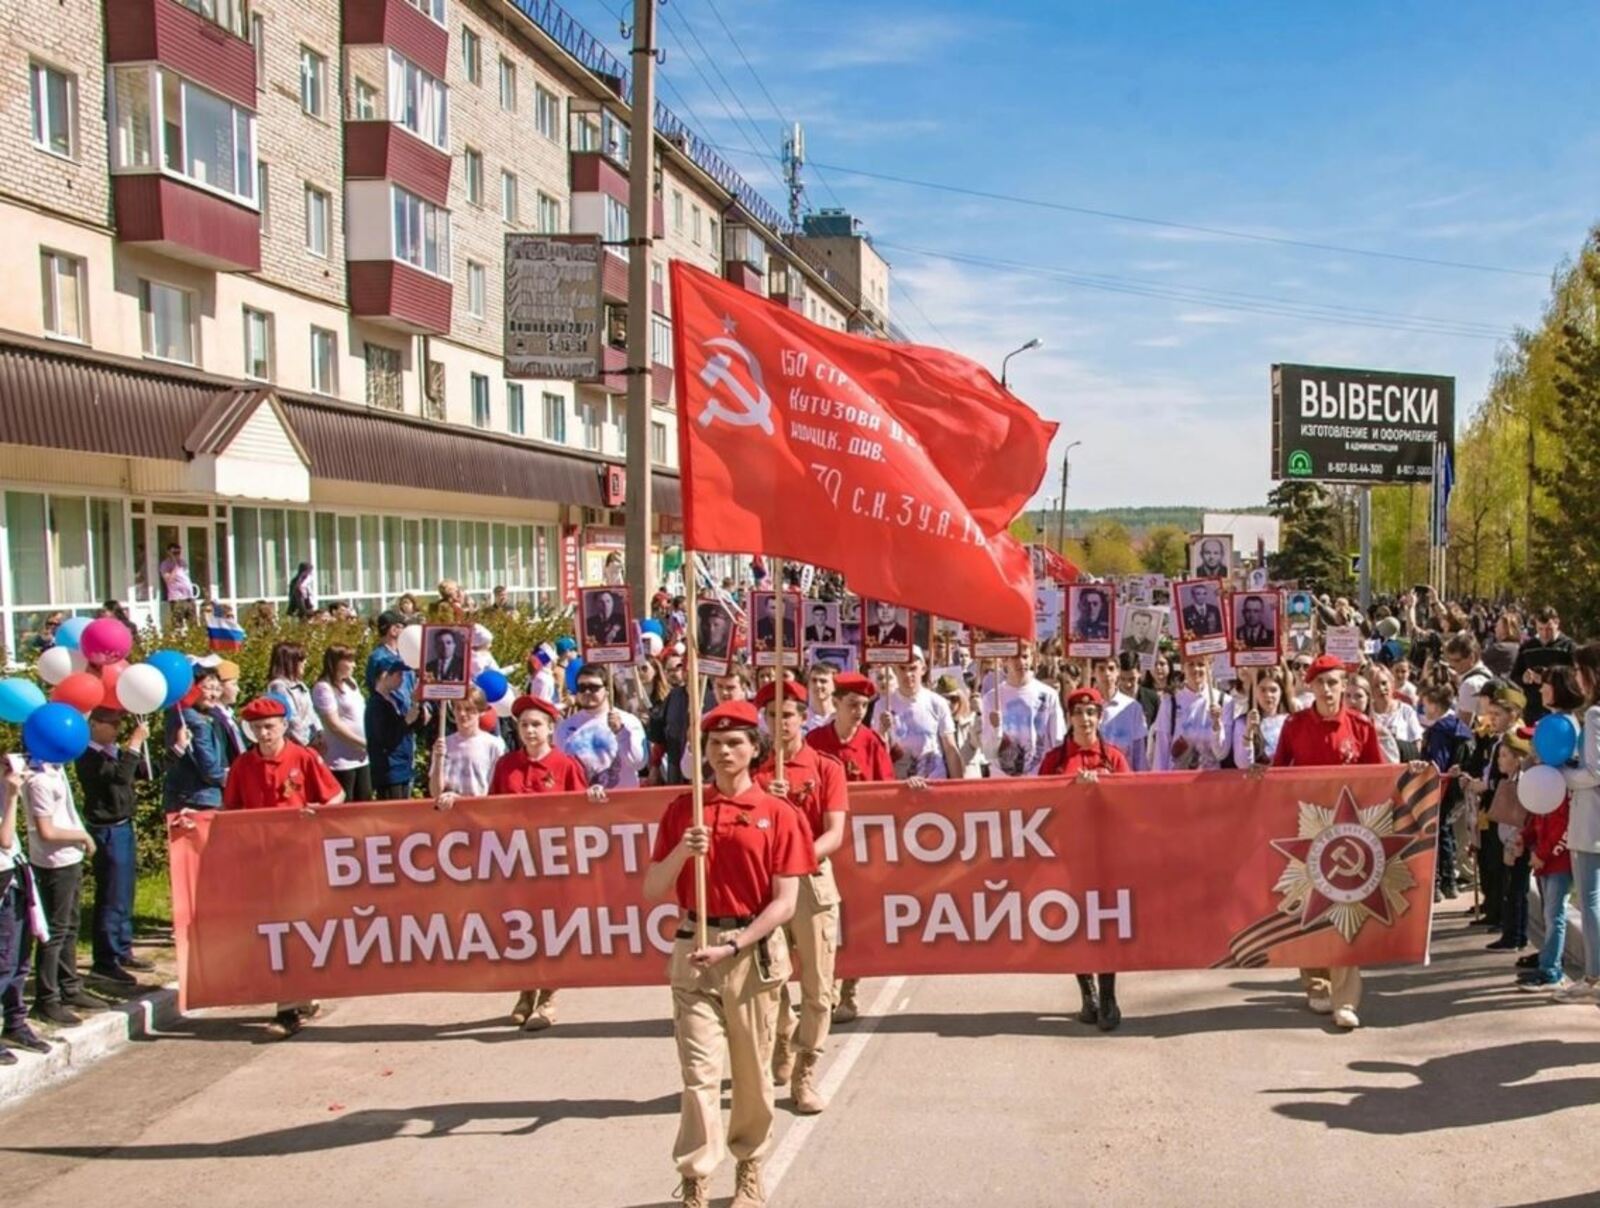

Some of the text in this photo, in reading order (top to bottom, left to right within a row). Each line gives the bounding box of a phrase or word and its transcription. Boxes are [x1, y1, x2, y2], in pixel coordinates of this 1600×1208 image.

[781, 349, 808, 377] 150
[1301, 379, 1439, 425] ВЫВЕСКИ
[1301, 424, 1438, 442] ИЗГОТОВЛЕНИЕ И ОФОРМЛЕНИЕ
[848, 436, 886, 463] ДИВ.
[897, 495, 914, 526] 3
[323, 807, 1056, 887] БЕССМЕРТ ПОЛК
[257, 878, 1134, 972] ТУЙМАЗИНС РАЙОН
